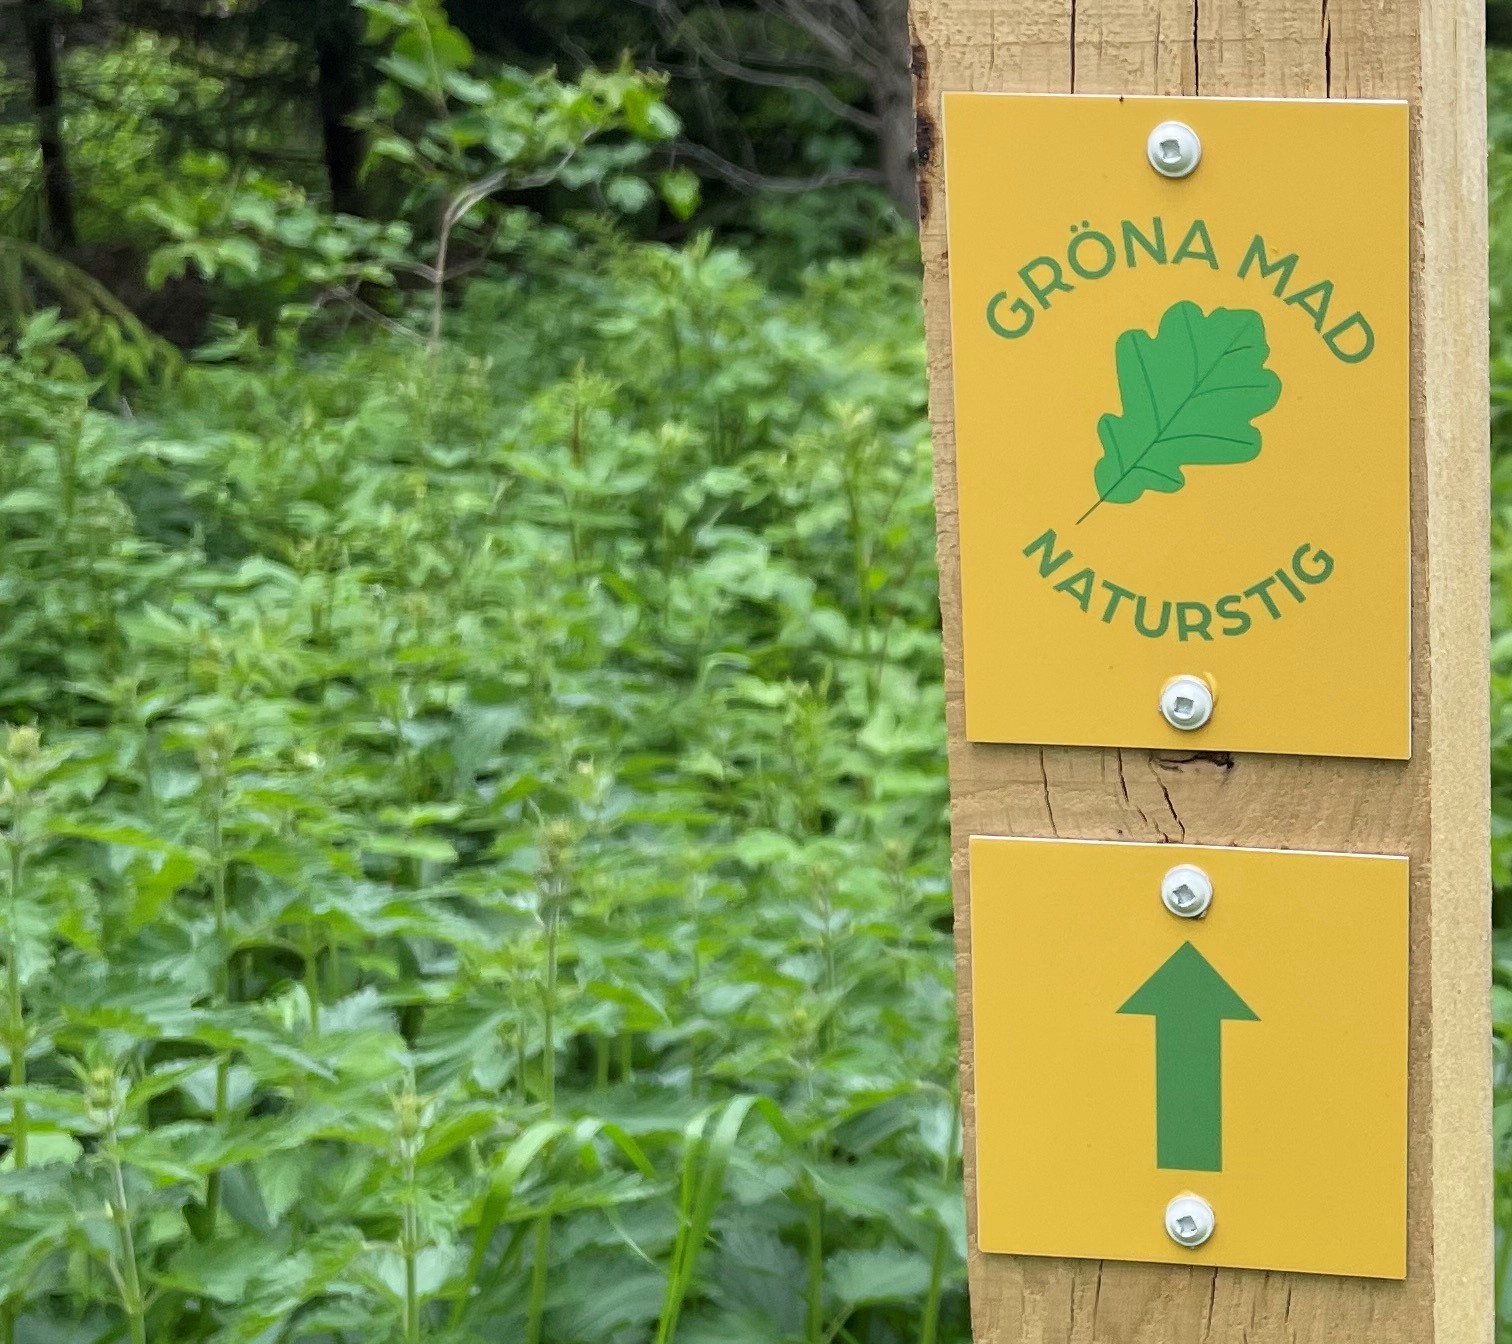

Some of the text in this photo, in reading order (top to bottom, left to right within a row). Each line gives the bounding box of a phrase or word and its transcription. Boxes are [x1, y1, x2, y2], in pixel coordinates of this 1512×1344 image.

[986, 216, 1375, 364] GRÖNA MAD
[1022, 528, 1335, 641] NATURSTIG
